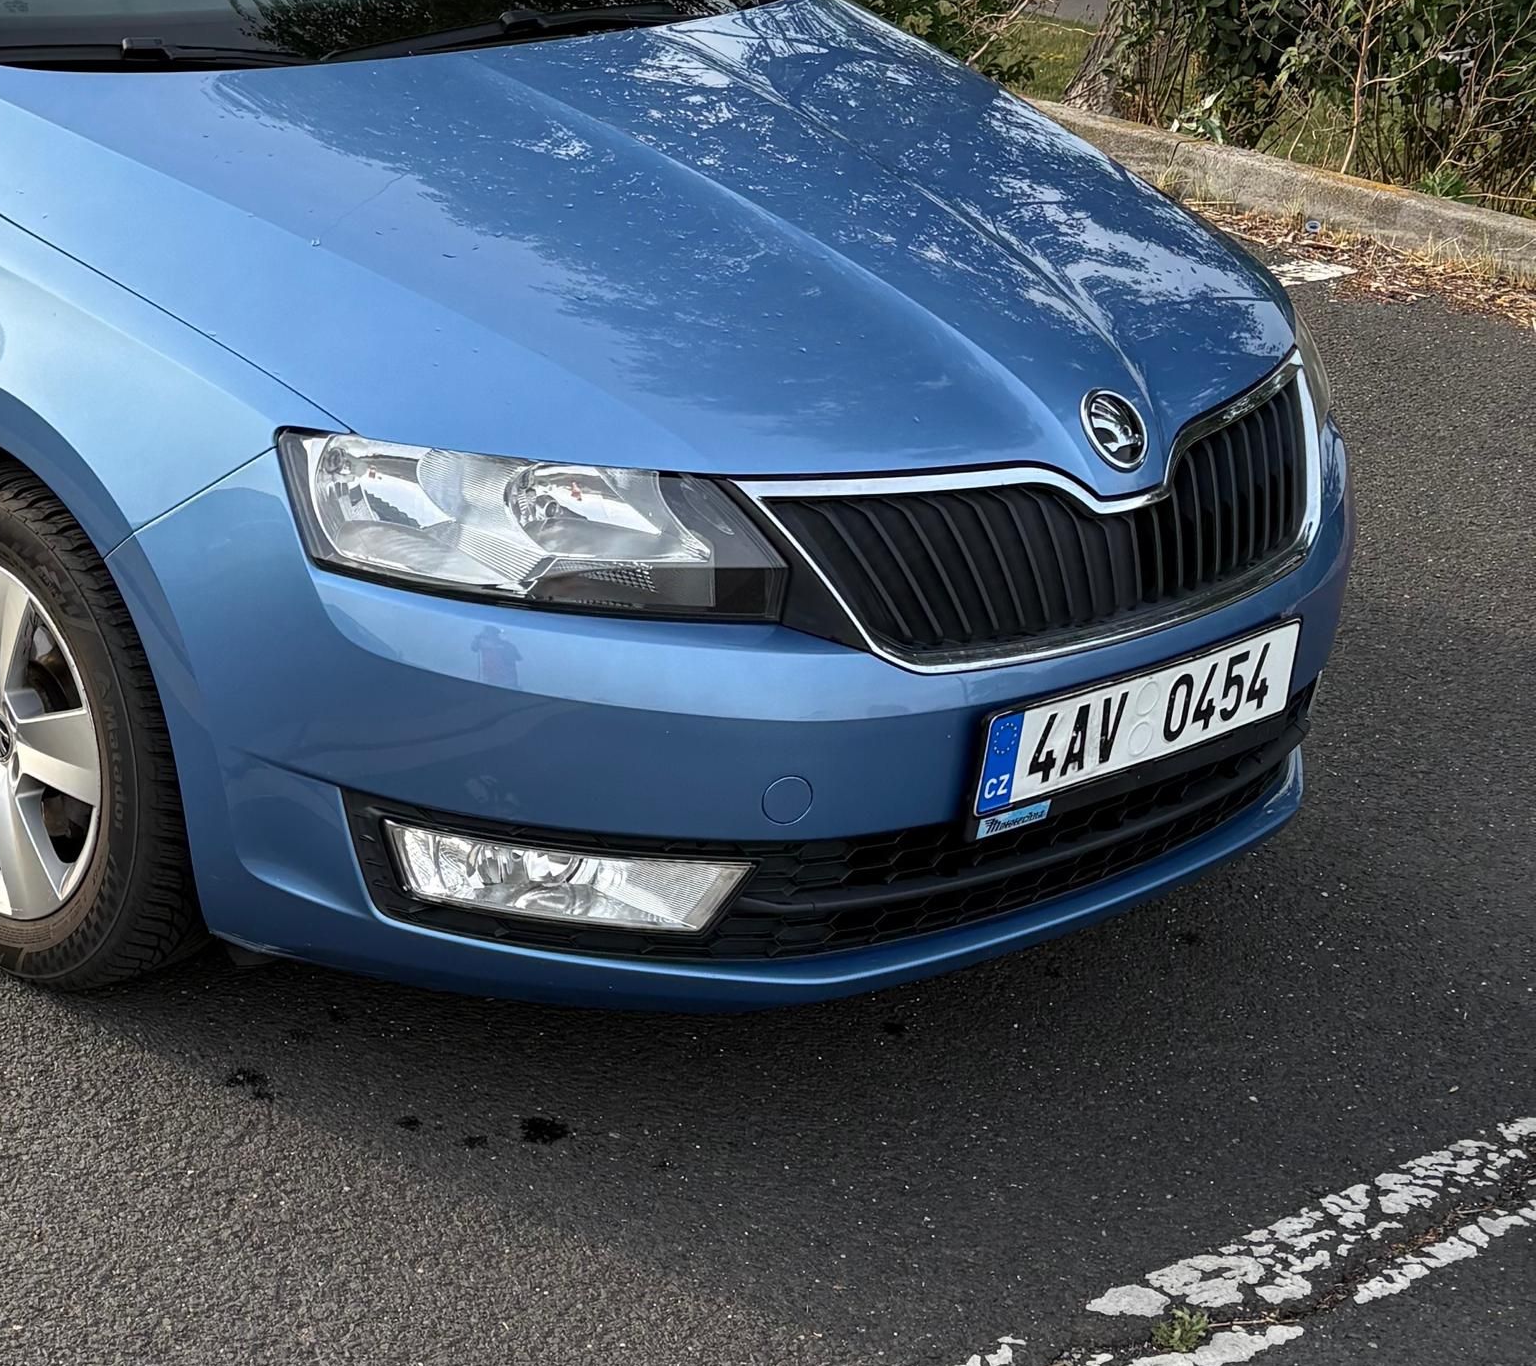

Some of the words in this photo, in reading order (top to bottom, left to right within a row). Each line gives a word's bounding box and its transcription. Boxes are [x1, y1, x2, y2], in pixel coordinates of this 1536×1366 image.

[103, 704, 126, 834] Matador
[1028, 691, 1129, 783] 4AV
[1164, 642, 1271, 743] 0454
[984, 775, 1010, 800] CZ
